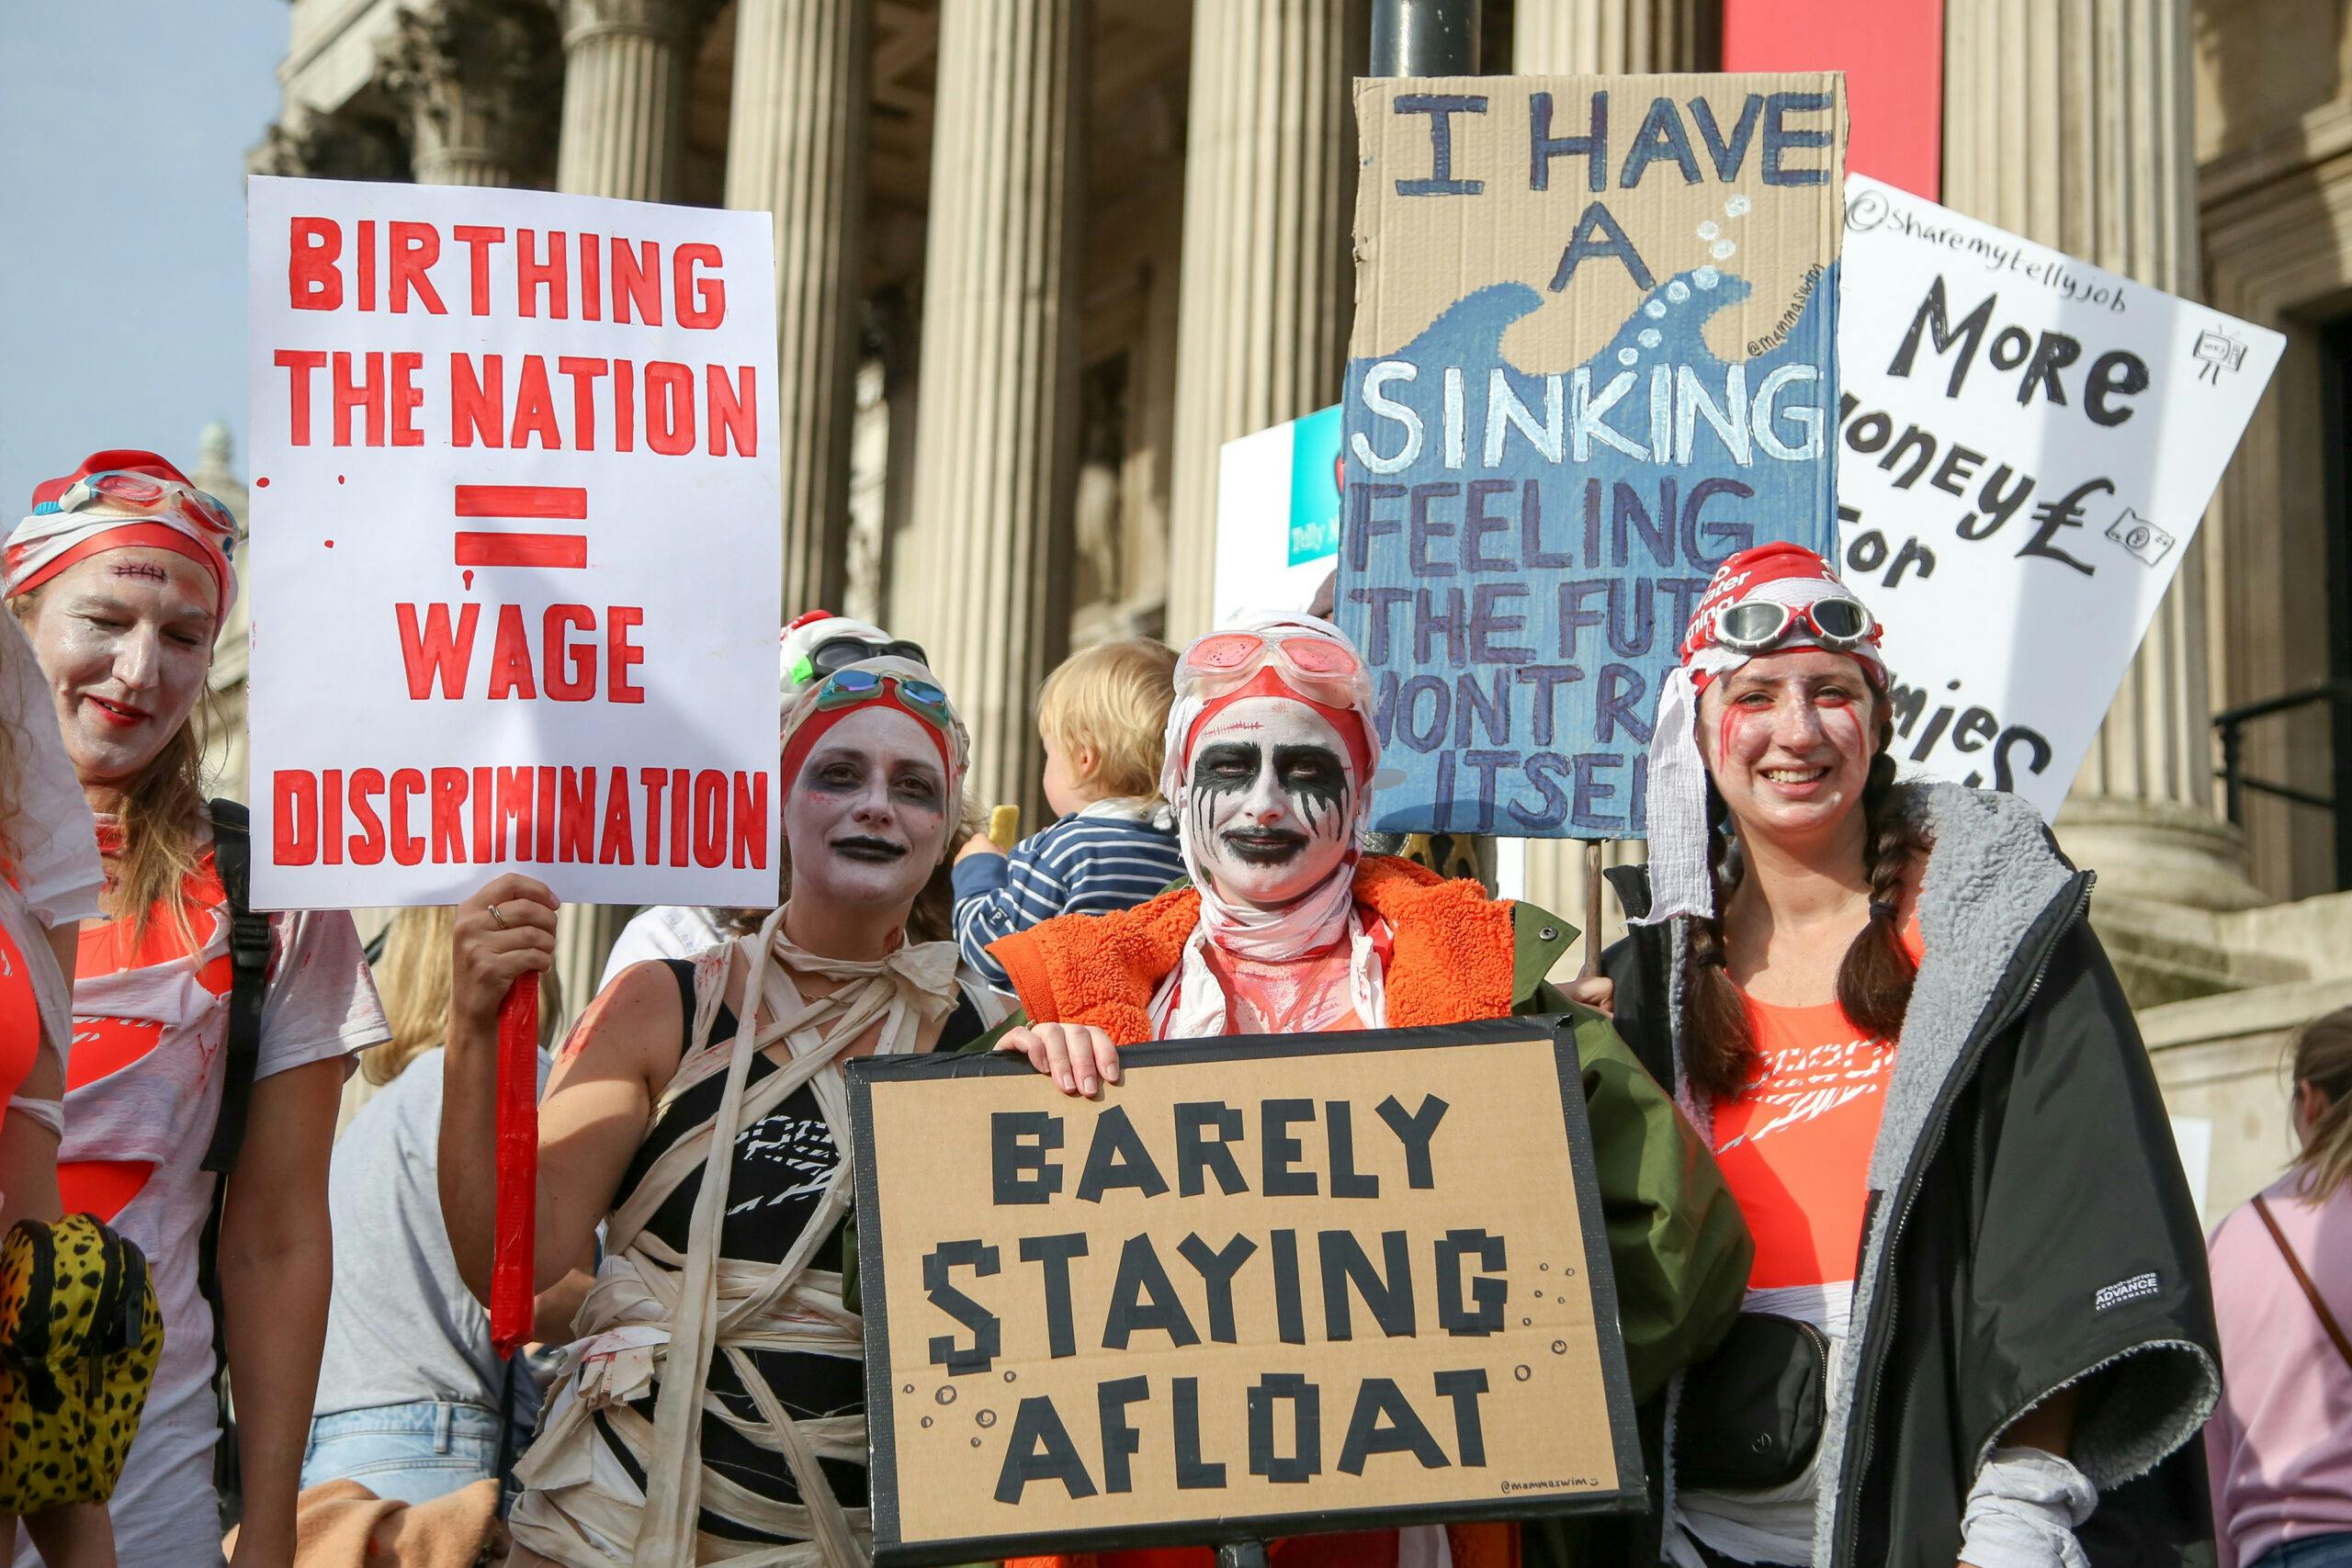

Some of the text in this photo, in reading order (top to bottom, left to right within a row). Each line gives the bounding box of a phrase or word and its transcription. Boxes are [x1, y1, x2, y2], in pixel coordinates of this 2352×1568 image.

[1394, 90, 1833, 196] I HAVE
[289, 217, 726, 330] BIRTHING
[1548, 200, 1656, 292] A
[274, 349, 758, 457] THE NATION
[1350, 361, 1826, 474] SINKING
[1348, 476, 1755, 577] FEELING
[396, 603, 644, 704] WAGE
[1349, 578, 1707, 669] THE FUT
[1594, 663, 1668, 745] R
[273, 765, 768, 870] DISCRIMINATION
[991, 1093, 1449, 1205] BARELY
[922, 1228, 1509, 1376] STAYING
[2096, 1278, 2157, 1304] ADVANCE
[2096, 1288, 2158, 1311] PERFORMANCE
[993, 1369, 1490, 1504] AFLOAT
[1500, 1476, 1587, 1495] @mammaswim
